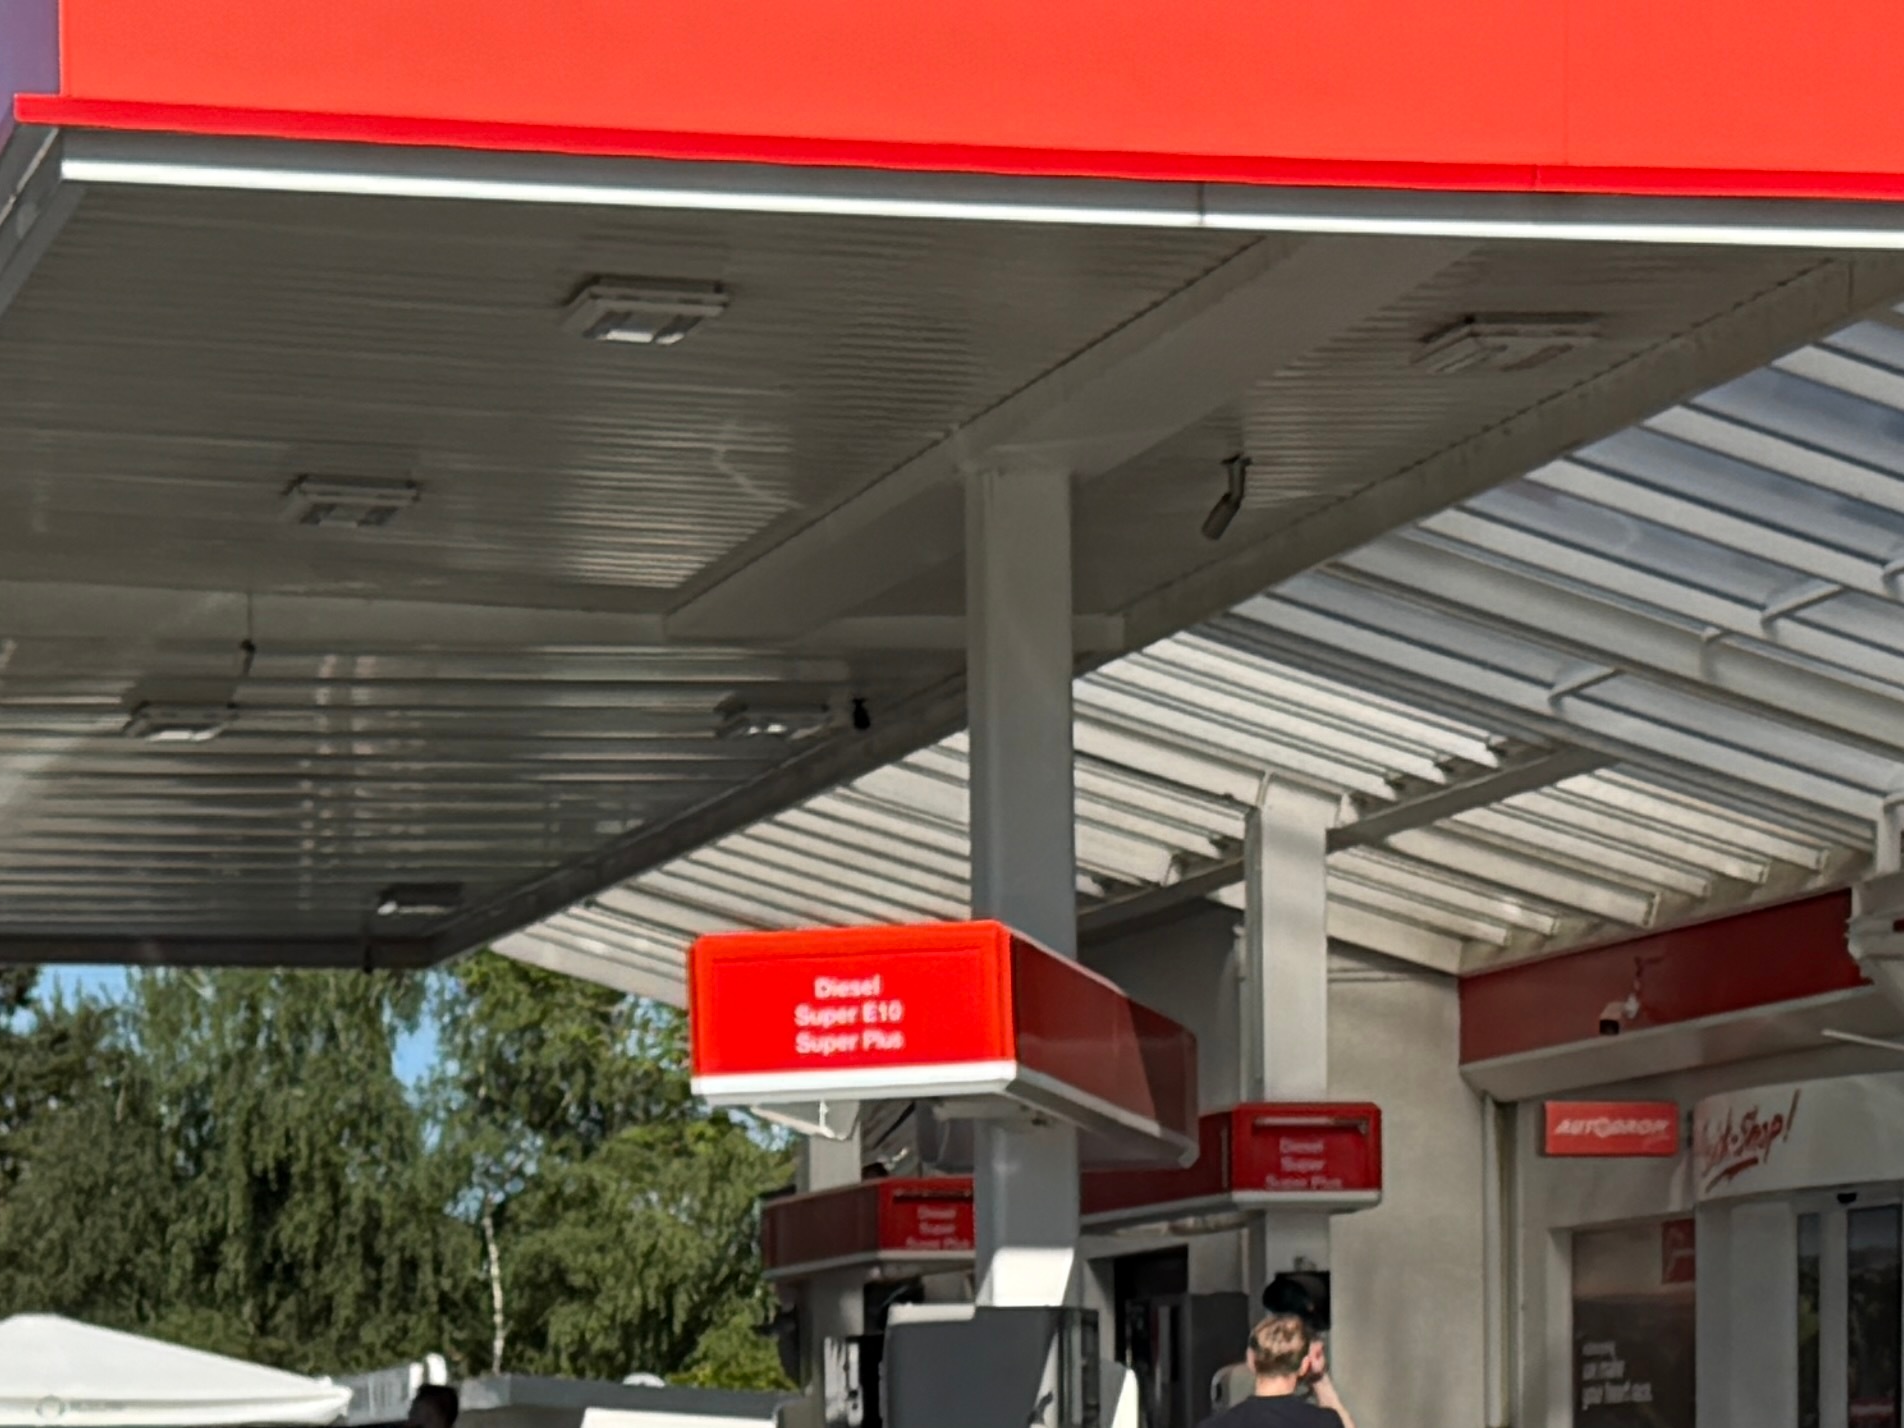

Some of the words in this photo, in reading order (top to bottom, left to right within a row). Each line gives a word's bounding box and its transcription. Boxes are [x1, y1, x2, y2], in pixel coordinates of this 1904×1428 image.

[814, 974, 883, 999] Diesel
[794, 1003, 859, 1028] Super
[862, 1000, 905, 1023] E10
[795, 1030, 859, 1055] Super
[862, 1029, 905, 1051] Plus
[1279, 1136, 1325, 1153] Diesel
[1280, 1156, 1325, 1173] Super
